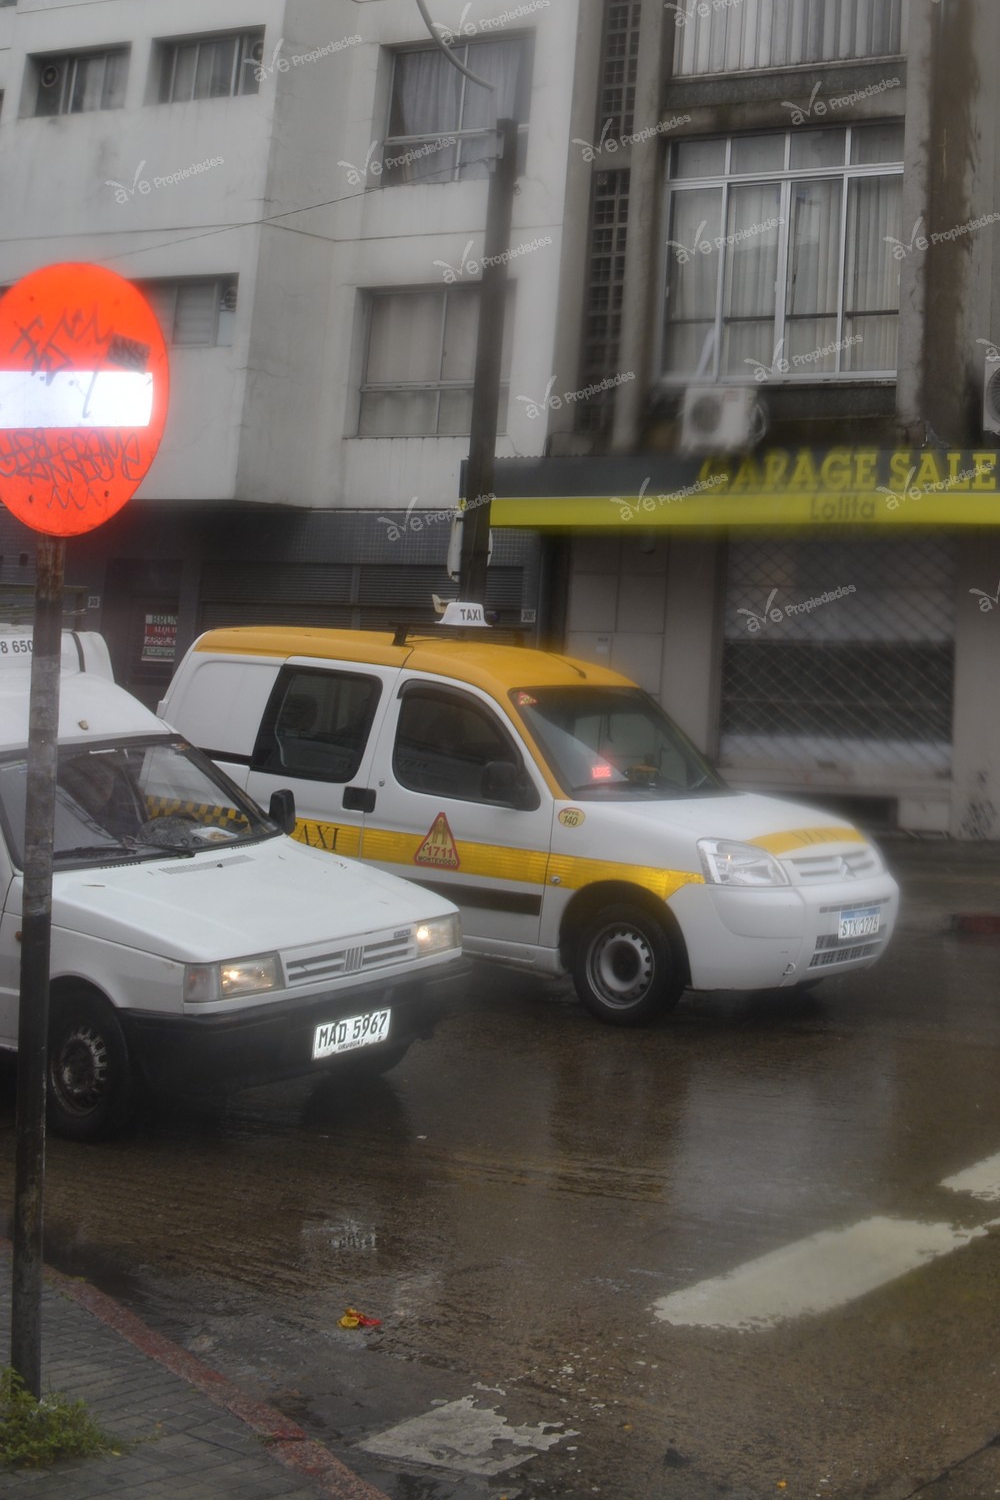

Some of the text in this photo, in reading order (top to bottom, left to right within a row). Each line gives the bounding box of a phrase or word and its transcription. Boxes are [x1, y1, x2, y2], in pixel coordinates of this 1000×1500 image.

[889, 452, 998, 491] SALE
[809, 497, 877, 521] Lolita
[460, 608, 482, 621] TAXI
[563, 815, 579, 827] 140
[295, 821, 341, 851] AXI
[426, 845, 454, 859] 1711
[842, 919, 858, 936] STX
[318, 1012, 388, 1049] MAD 5967
